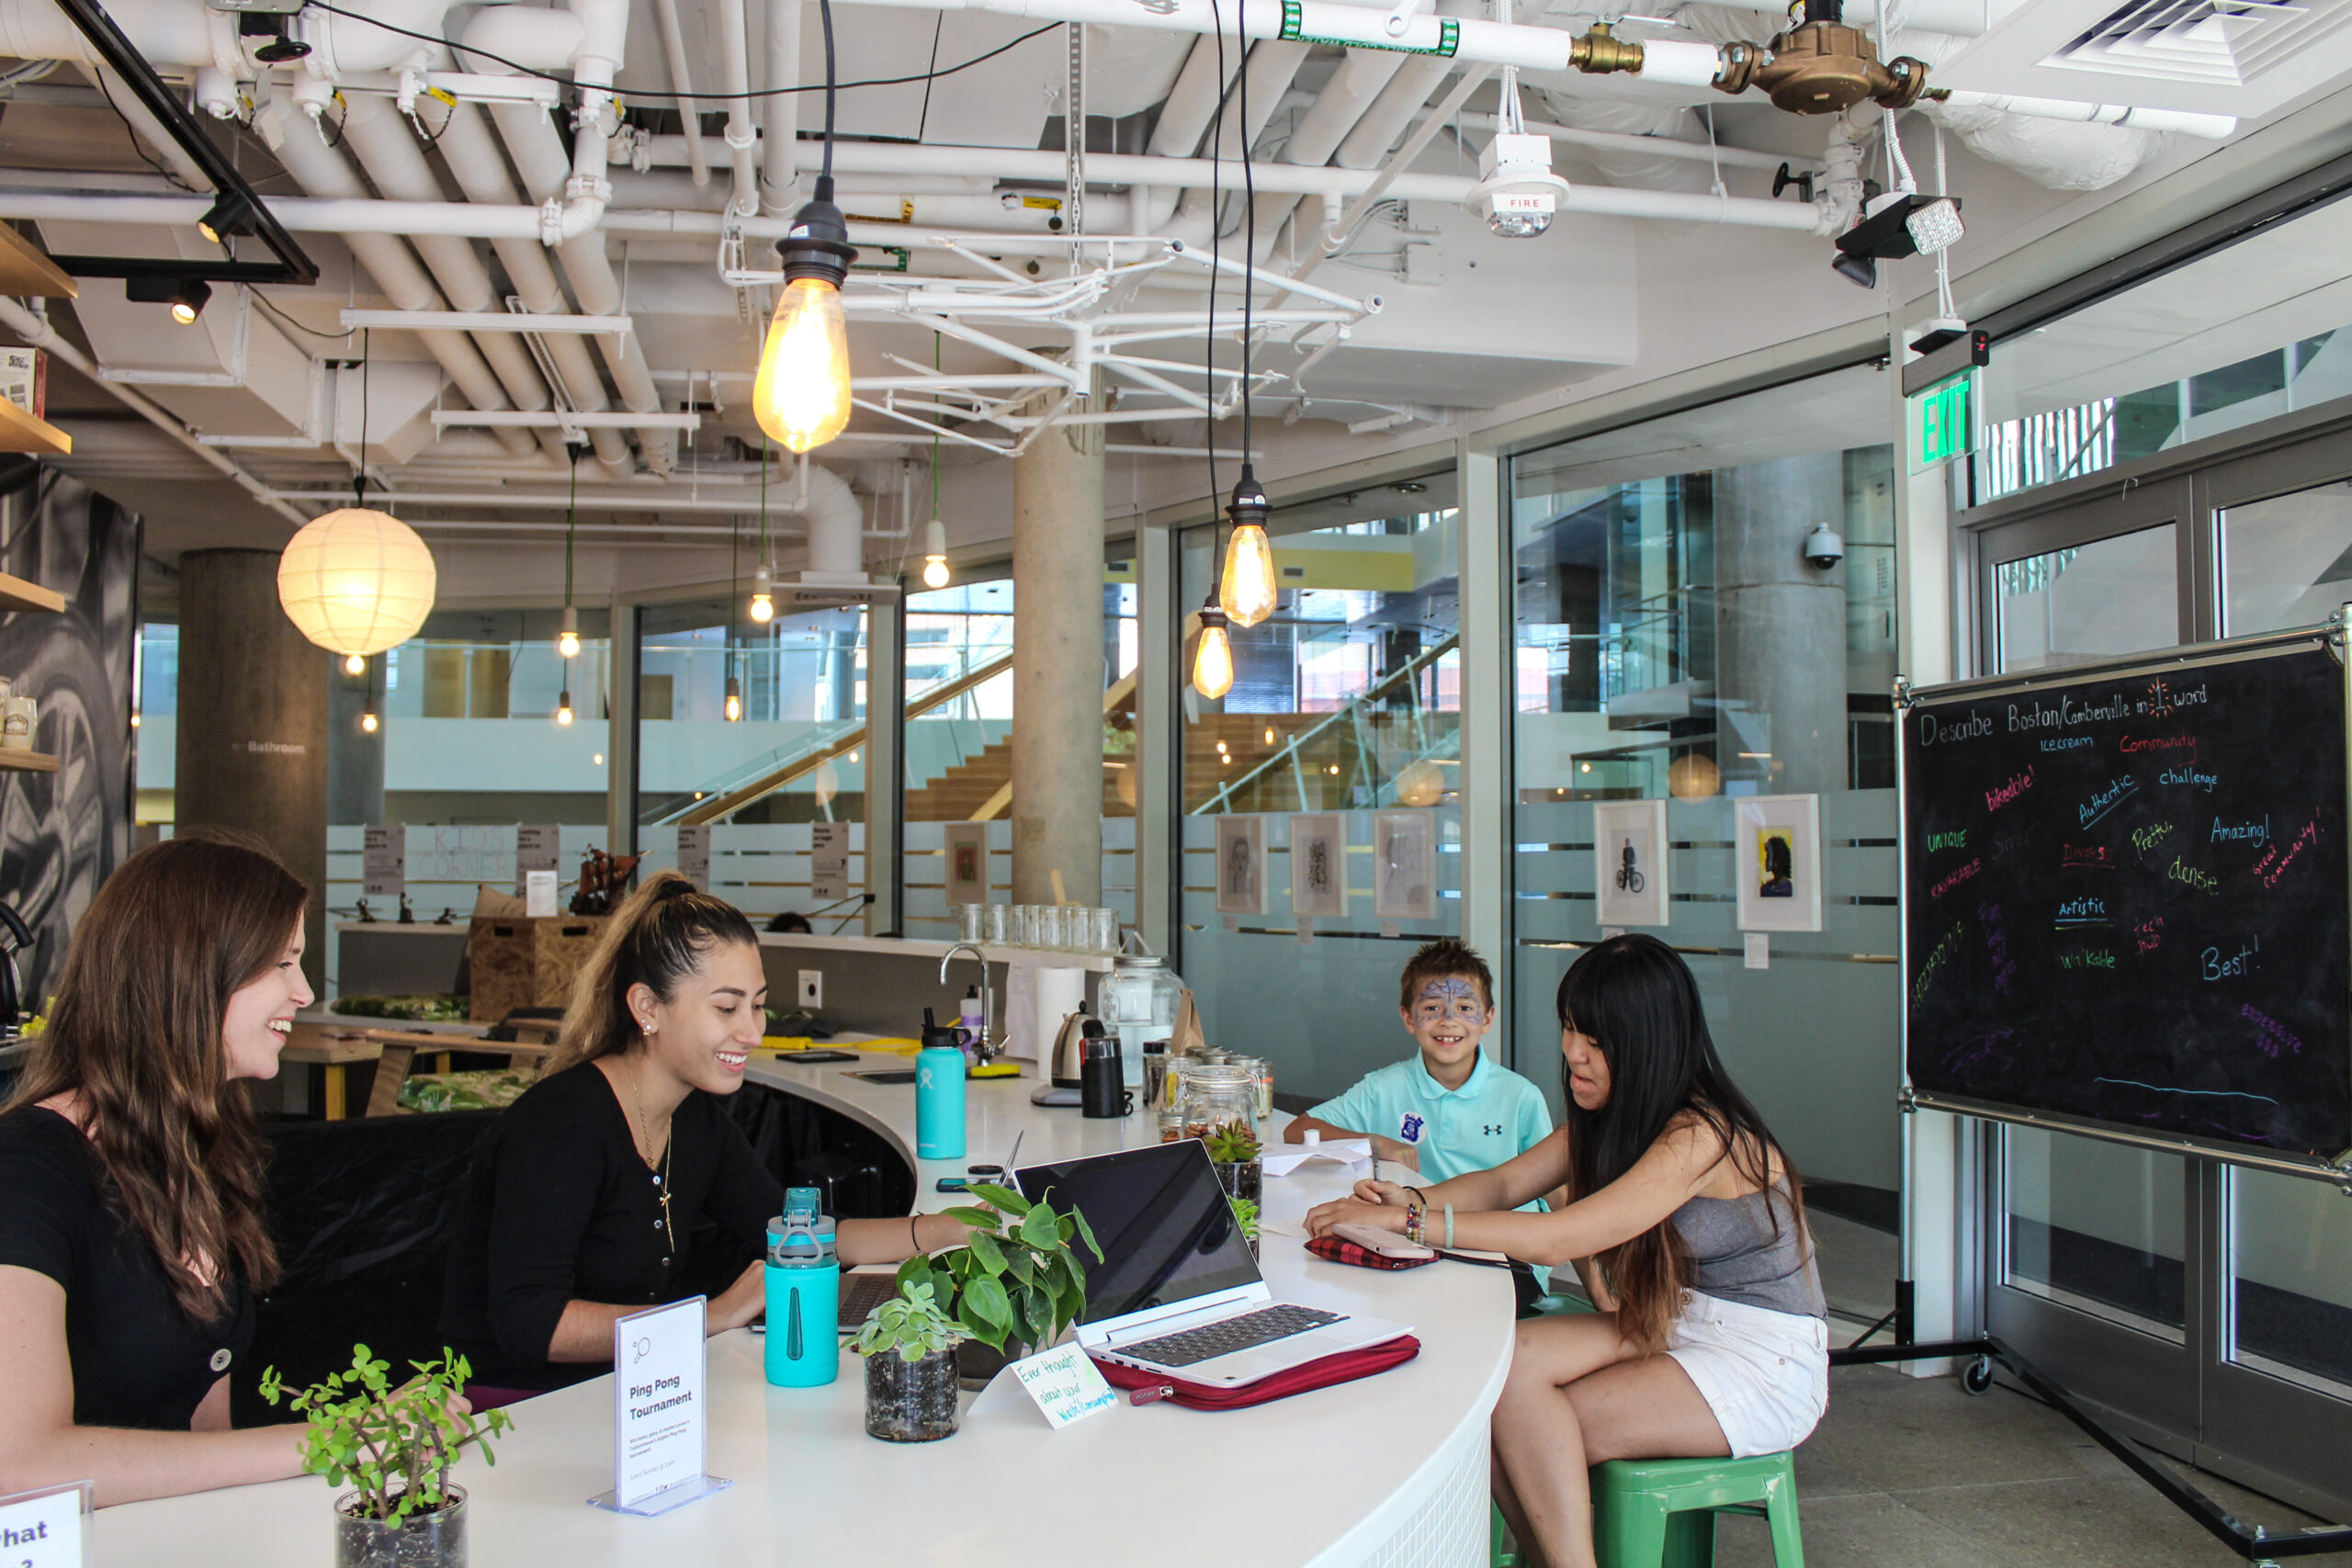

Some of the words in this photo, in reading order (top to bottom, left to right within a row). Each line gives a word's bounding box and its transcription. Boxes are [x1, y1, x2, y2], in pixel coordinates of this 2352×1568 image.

[1510, 199, 1540, 208] FIRE
[1922, 379, 1970, 464] EXIT
[1920, 708, 1994, 747] Describe
[2008, 694, 2131, 731] Boston/Camberville
[2136, 698, 2148, 714] in
[2174, 683, 2208, 707] word
[248, 740, 307, 755] Bathroom
[2120, 728, 2197, 767] Community
[1985, 764, 2036, 812] bikeable!
[2078, 774, 2136, 825] Authentic
[435, 826, 506, 852] KIDS
[1928, 829, 1968, 852] UNIQUE
[2211, 814, 2271, 848] Amazing!
[2168, 855, 2220, 896] dense
[2059, 897, 2105, 917] Artistic
[2200, 933, 2261, 981] Best!
[1017, 1366, 1040, 1383] Ever
[1040, 1350, 1078, 1378] thought
[629, 1384, 652, 1400] Ping
[654, 1375, 680, 1392] Pong
[1039, 1384, 1063, 1404] about
[1063, 1382, 1082, 1404] your
[629, 1390, 693, 1420] Tournament
[0, 1520, 48, 1548] hat
